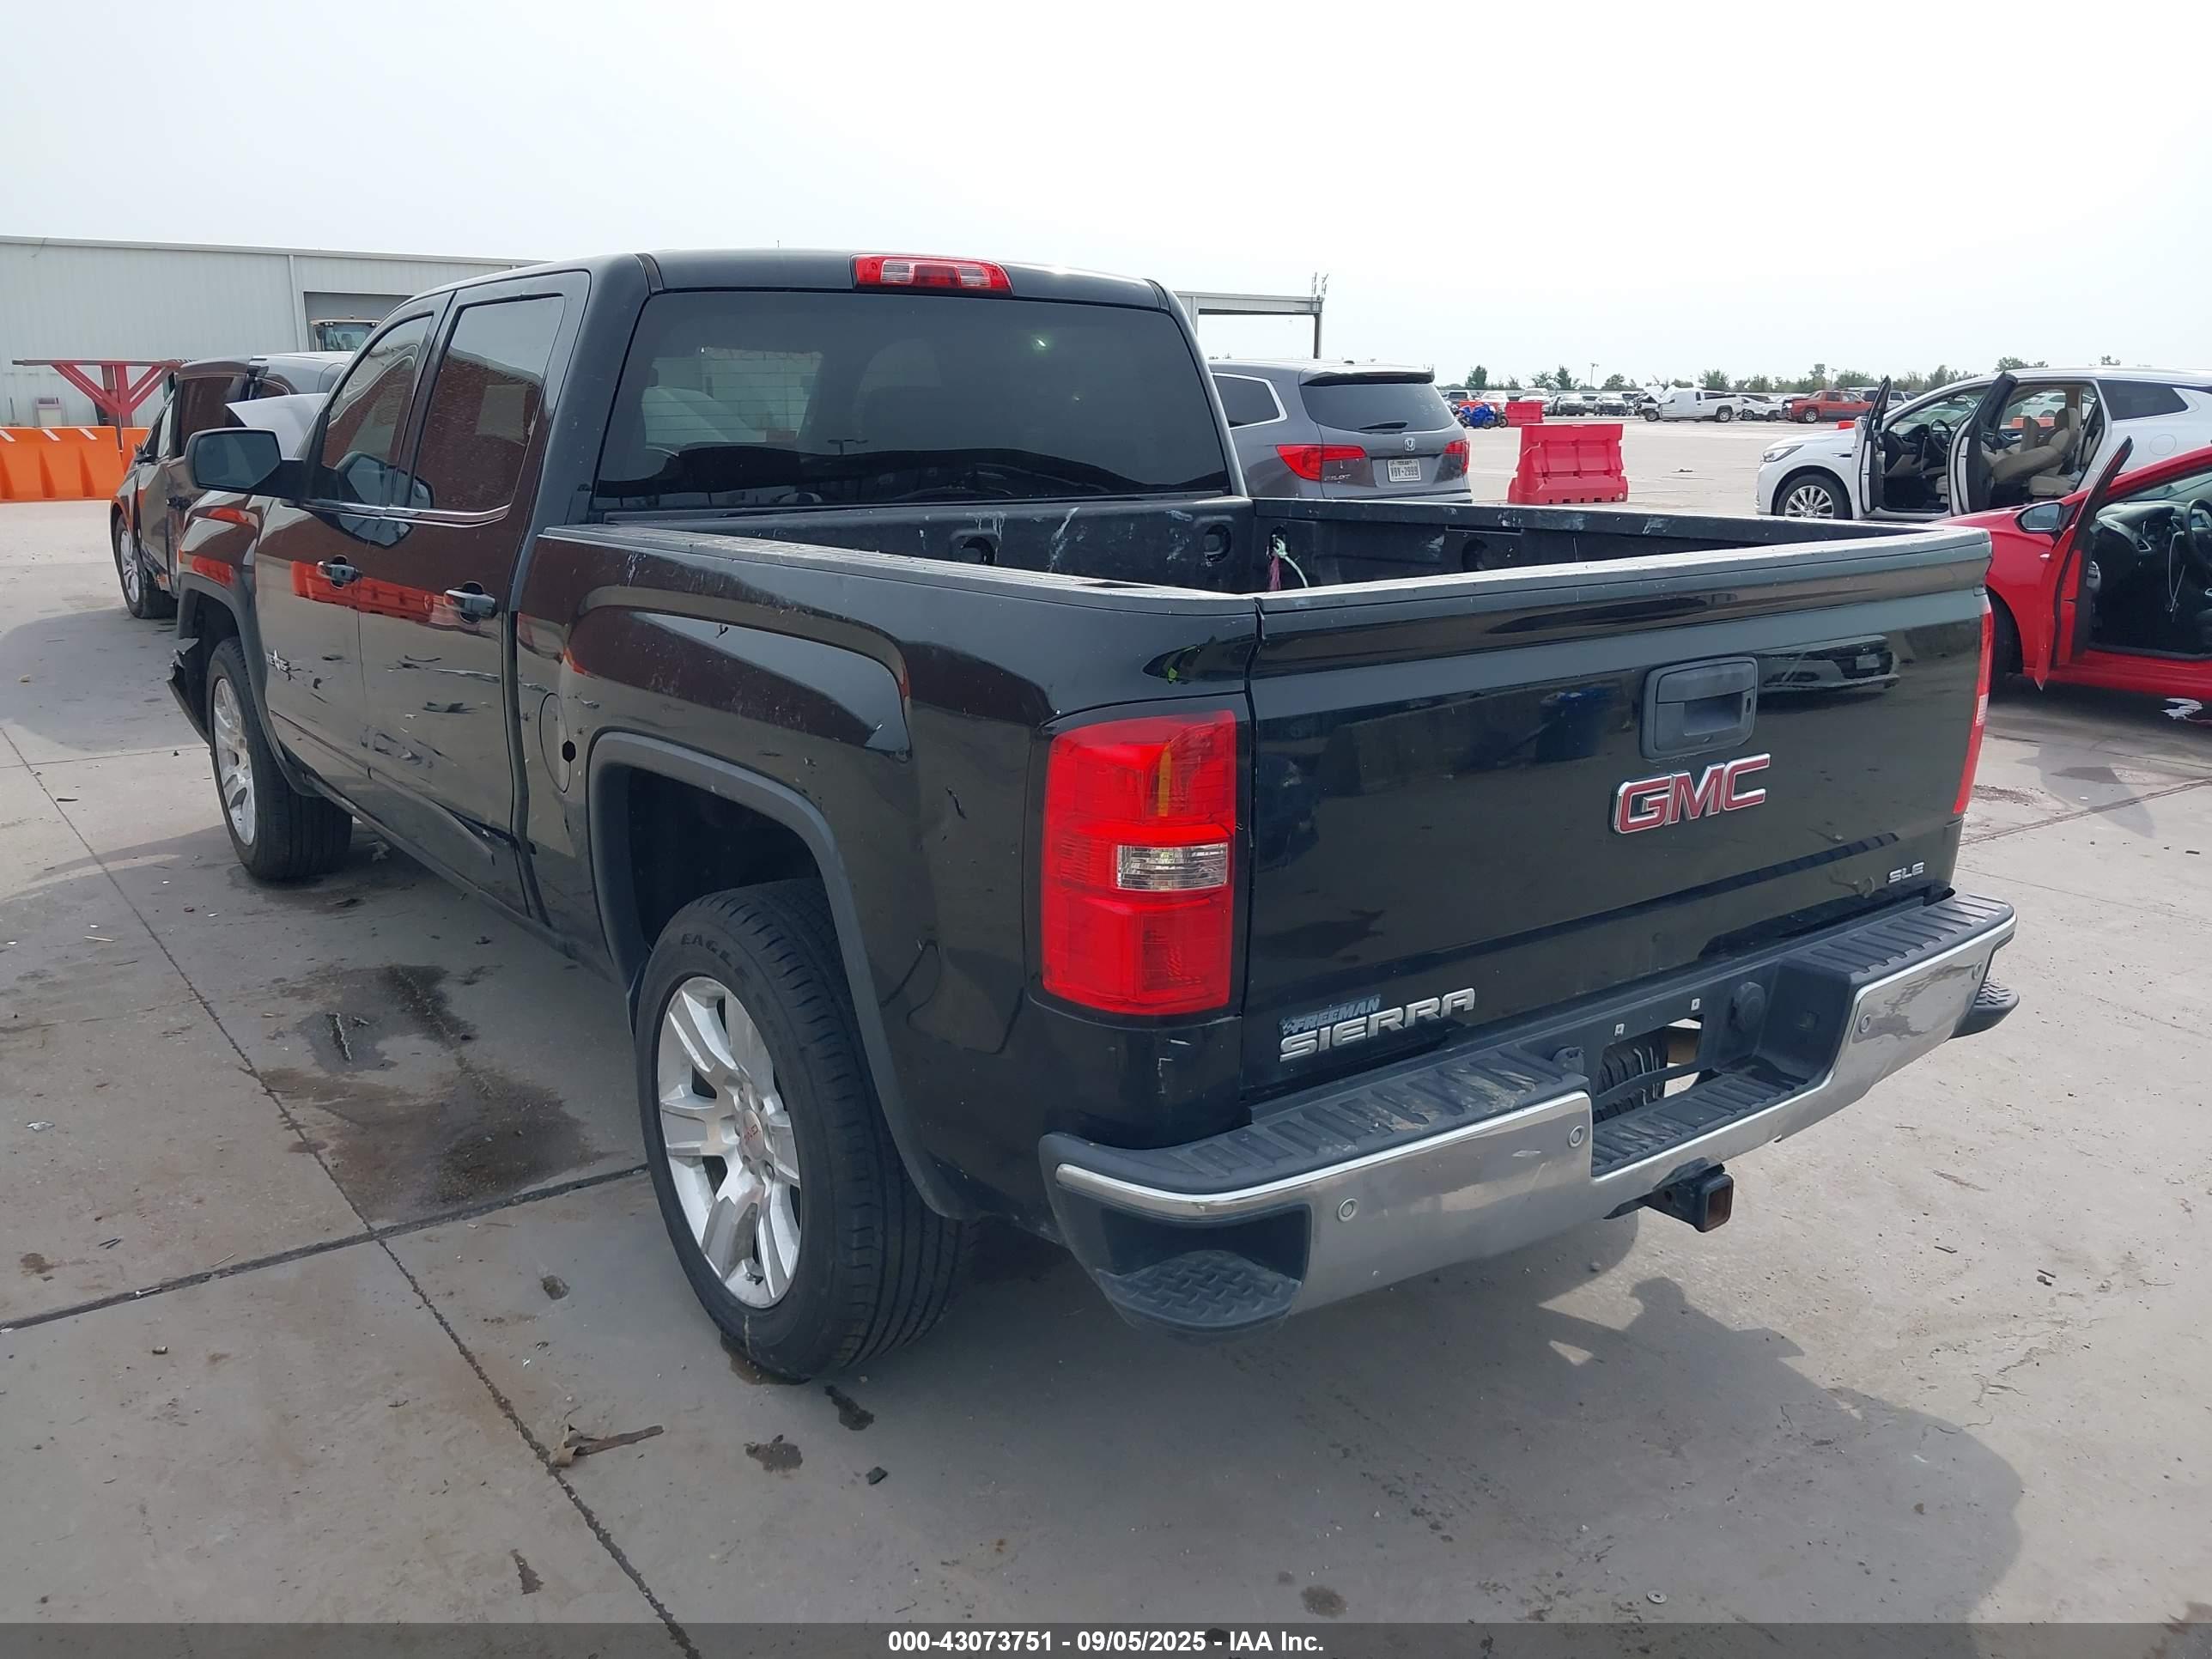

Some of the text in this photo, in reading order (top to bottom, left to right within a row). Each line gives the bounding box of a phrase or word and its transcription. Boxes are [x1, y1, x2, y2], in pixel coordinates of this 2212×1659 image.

[1614, 753, 1771, 835] GMC
[1888, 861, 1924, 884] SLE
[1279, 988, 1476, 1062] SIERRA
[1293, 996, 1381, 1033] FREEMAN
